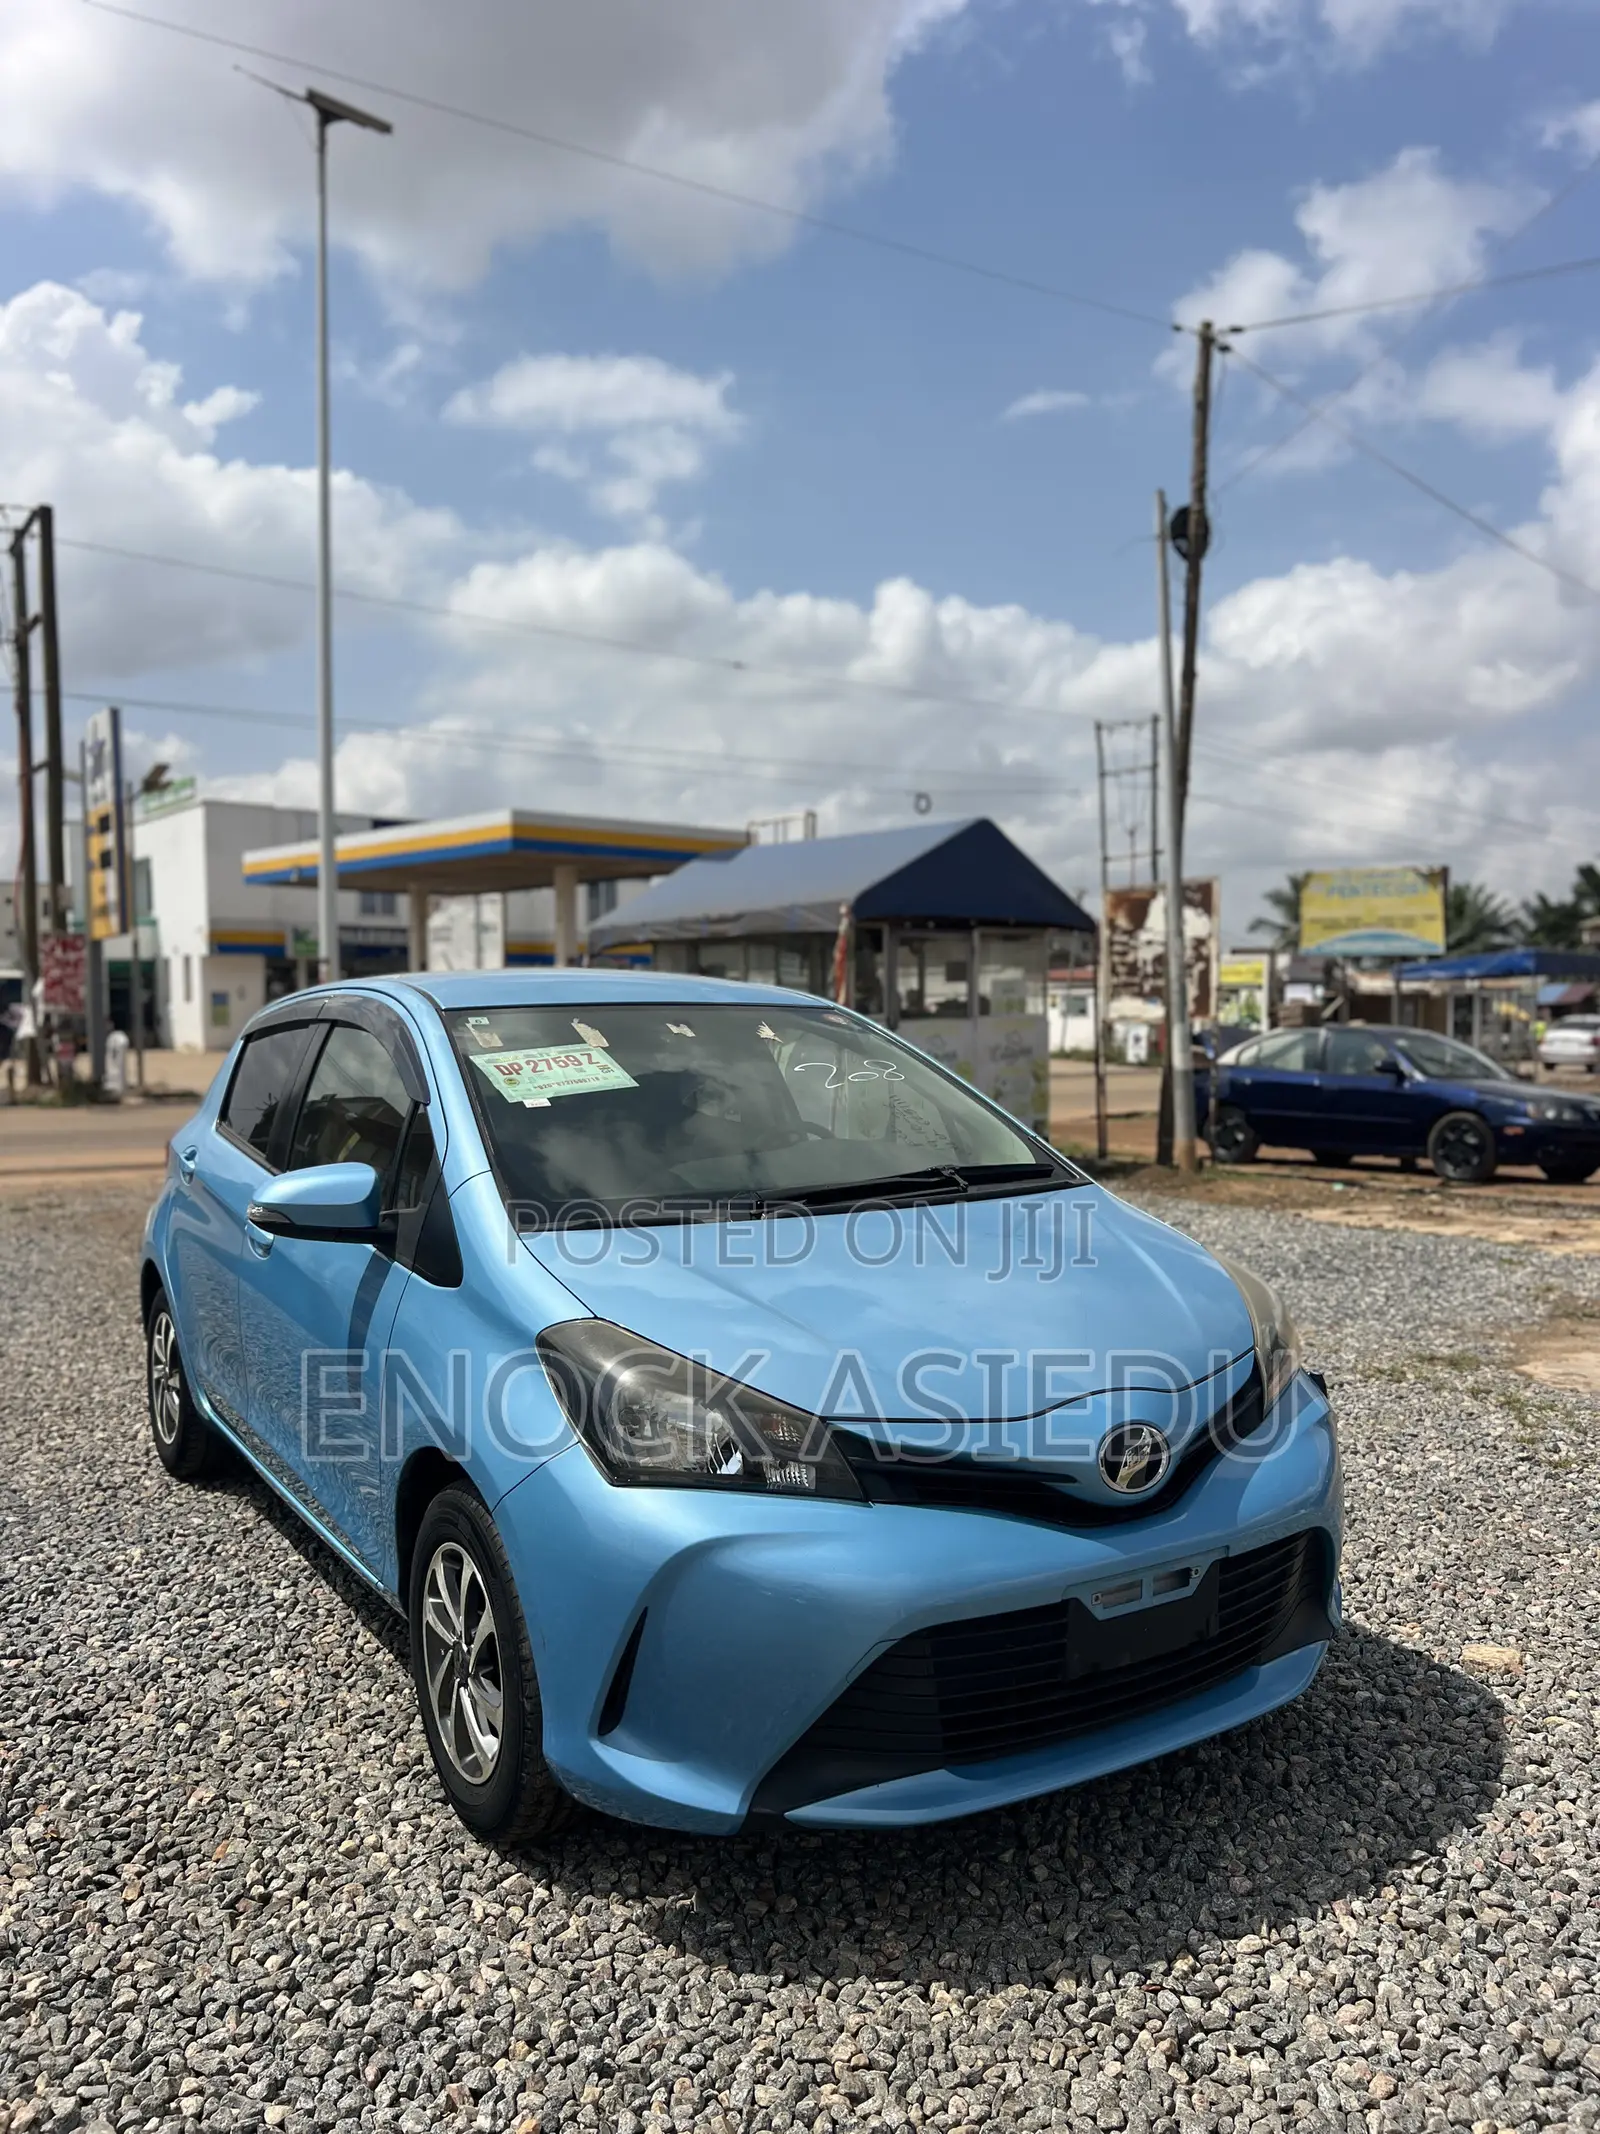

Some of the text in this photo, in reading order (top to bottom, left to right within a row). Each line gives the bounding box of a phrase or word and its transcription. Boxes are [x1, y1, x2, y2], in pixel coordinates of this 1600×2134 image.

[493, 1062, 524, 1077] DP
[525, 1054, 583, 1075] 2759
[580, 1052, 601, 1066] Z
